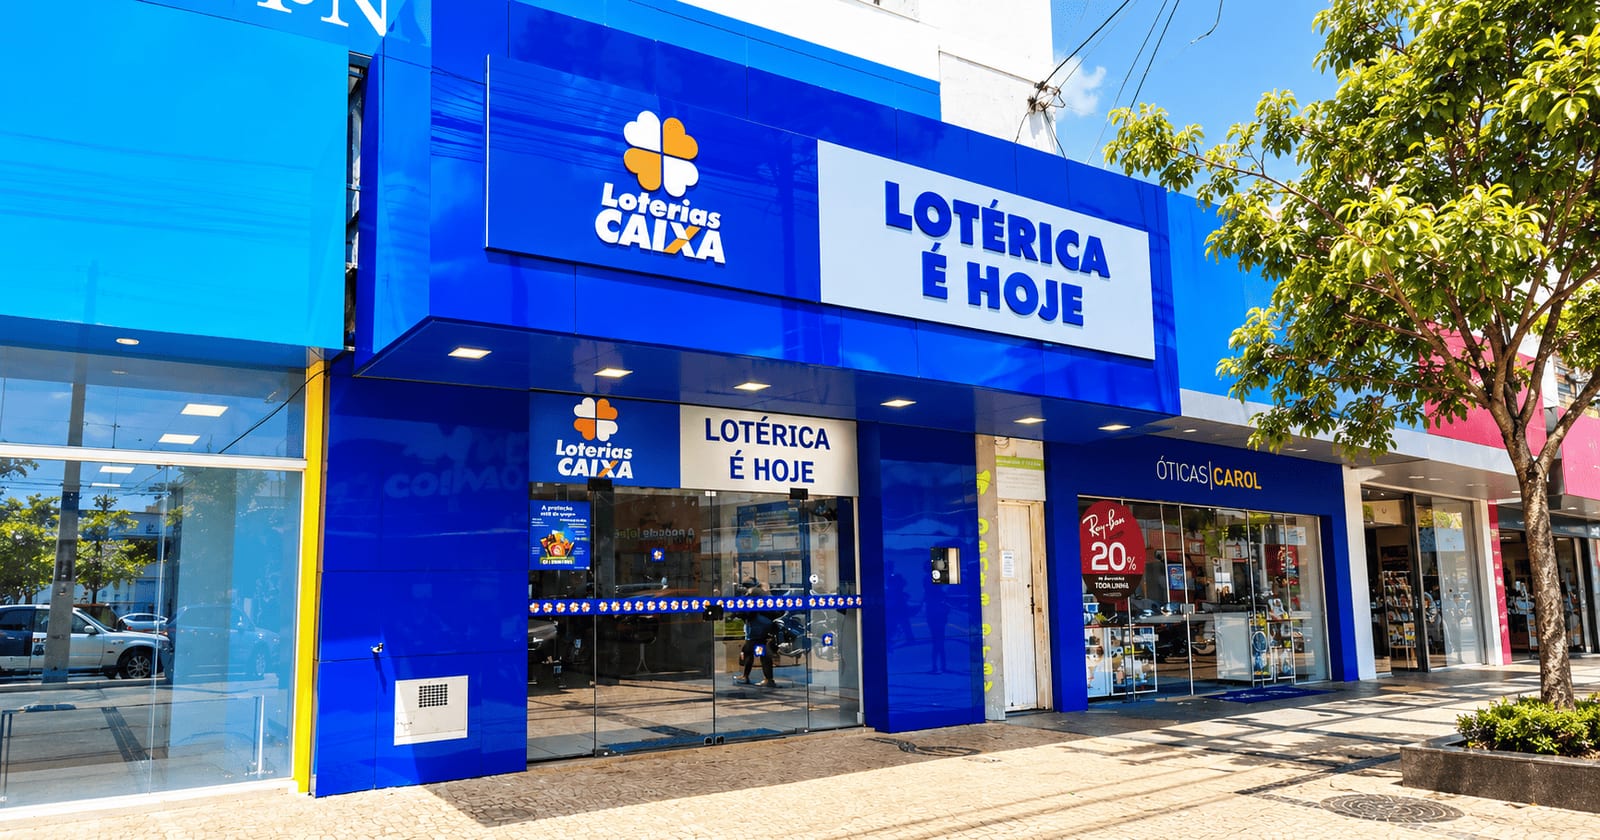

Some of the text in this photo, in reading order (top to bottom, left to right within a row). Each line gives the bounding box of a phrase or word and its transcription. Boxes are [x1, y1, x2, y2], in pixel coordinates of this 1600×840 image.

[601, 182, 721, 229] Loterias
[595, 208, 726, 264] CAIXA
[885, 180, 1110, 278] LOTÉRICA
[922, 242, 1084, 327] É HOJE
[556, 439, 633, 460] Loterias
[705, 416, 831, 450] LOTÉRICA
[558, 457, 634, 479] CAIXA
[730, 449, 815, 484] É HOJE
[1156, 455, 1262, 490] ÓTICAS CAROL
[1082, 508, 1126, 540] Ray-Ban
[1091, 541, 1137, 571] 20%
